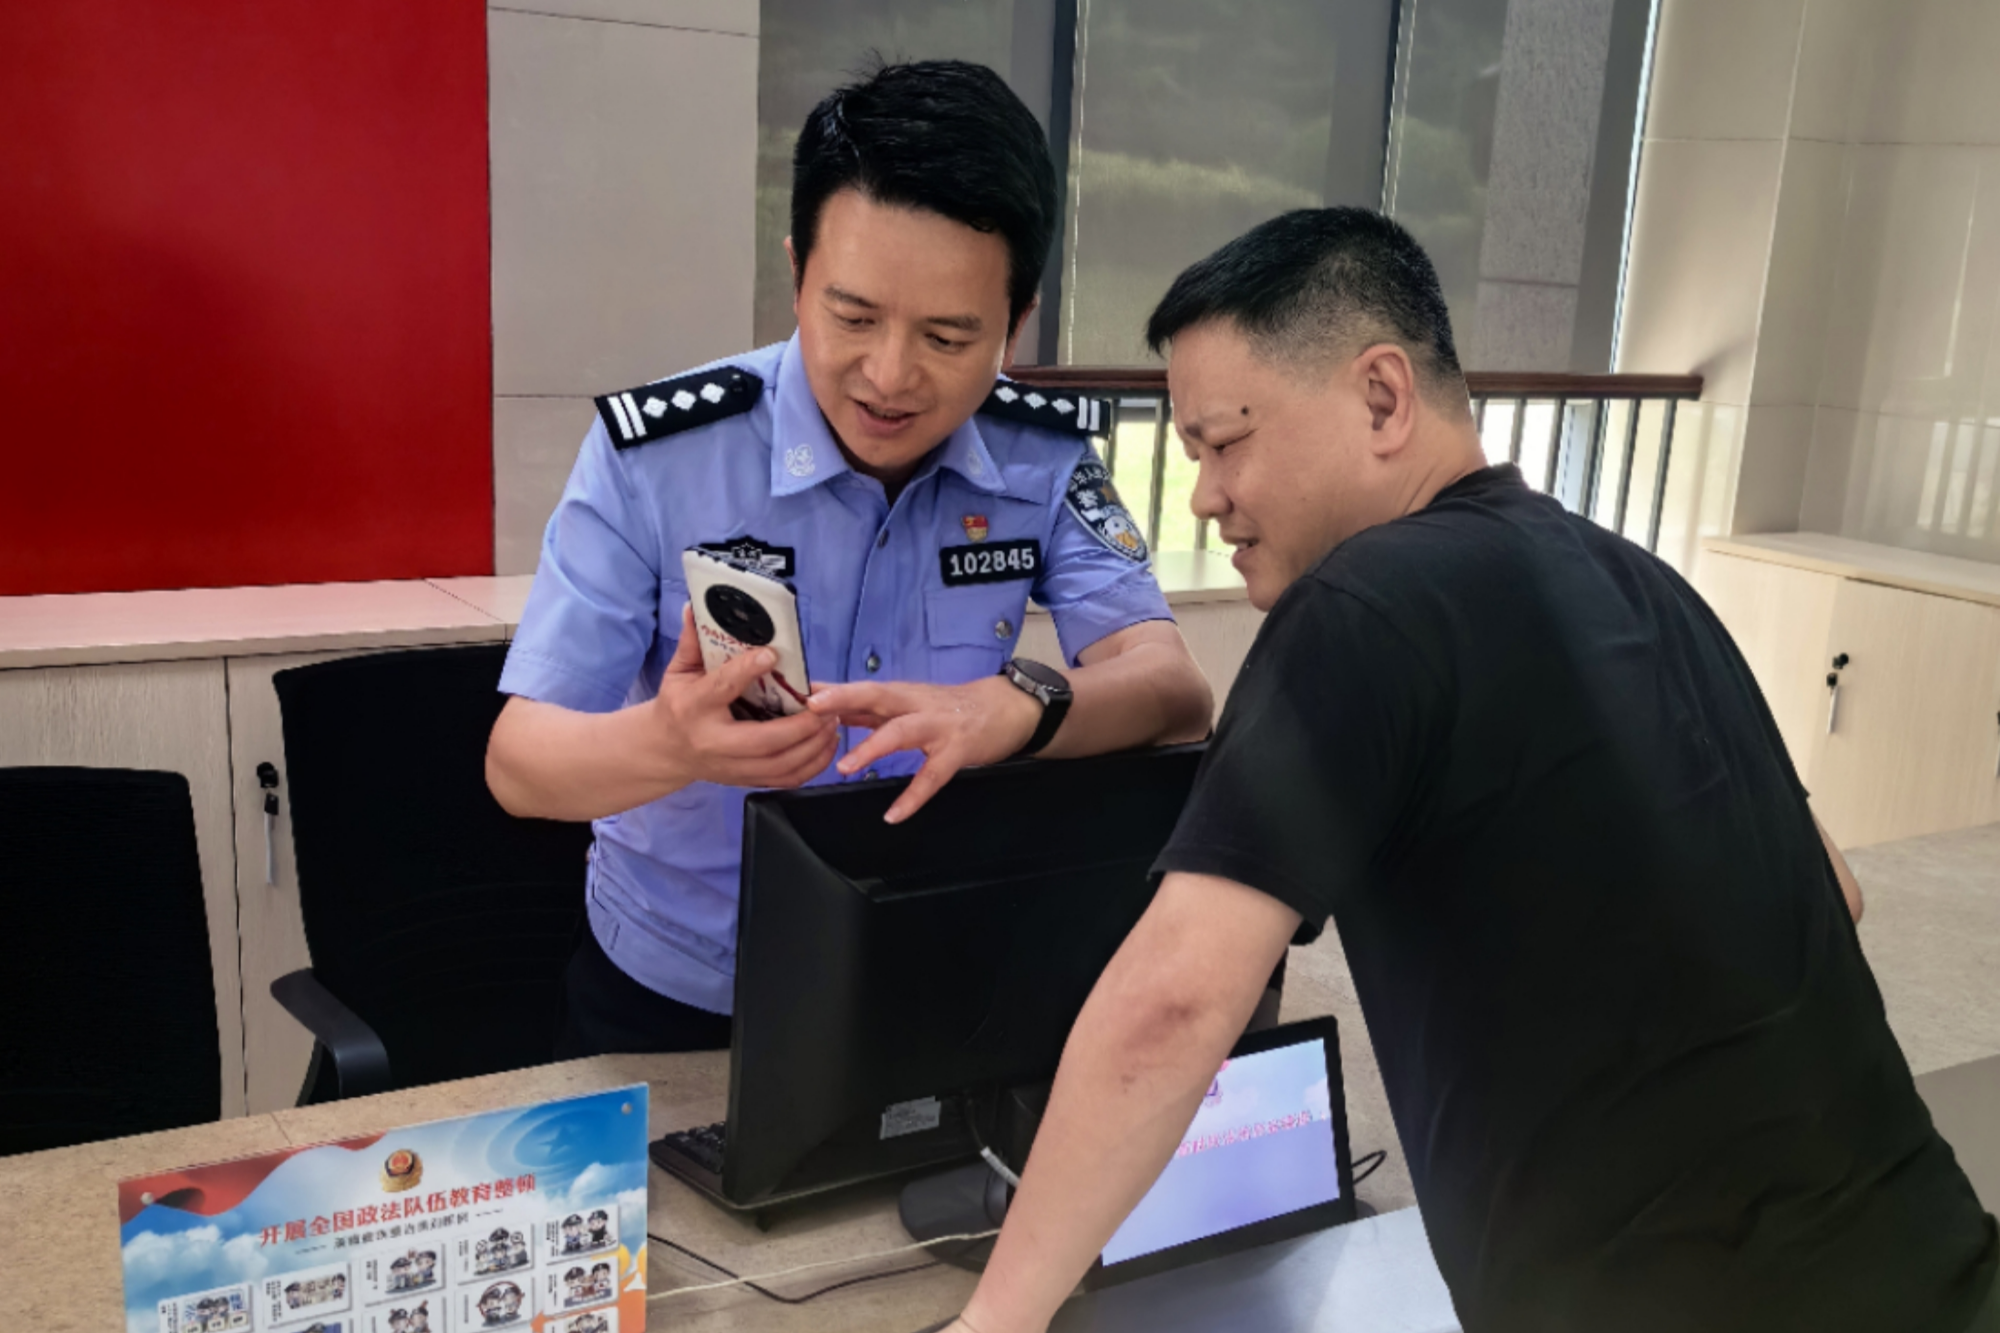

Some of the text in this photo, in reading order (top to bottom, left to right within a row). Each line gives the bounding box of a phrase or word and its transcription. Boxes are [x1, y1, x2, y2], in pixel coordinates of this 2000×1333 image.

[950, 547, 1035, 576] 102845
[259, 1172, 536, 1248] 开展全国政法队伍教育整顿
